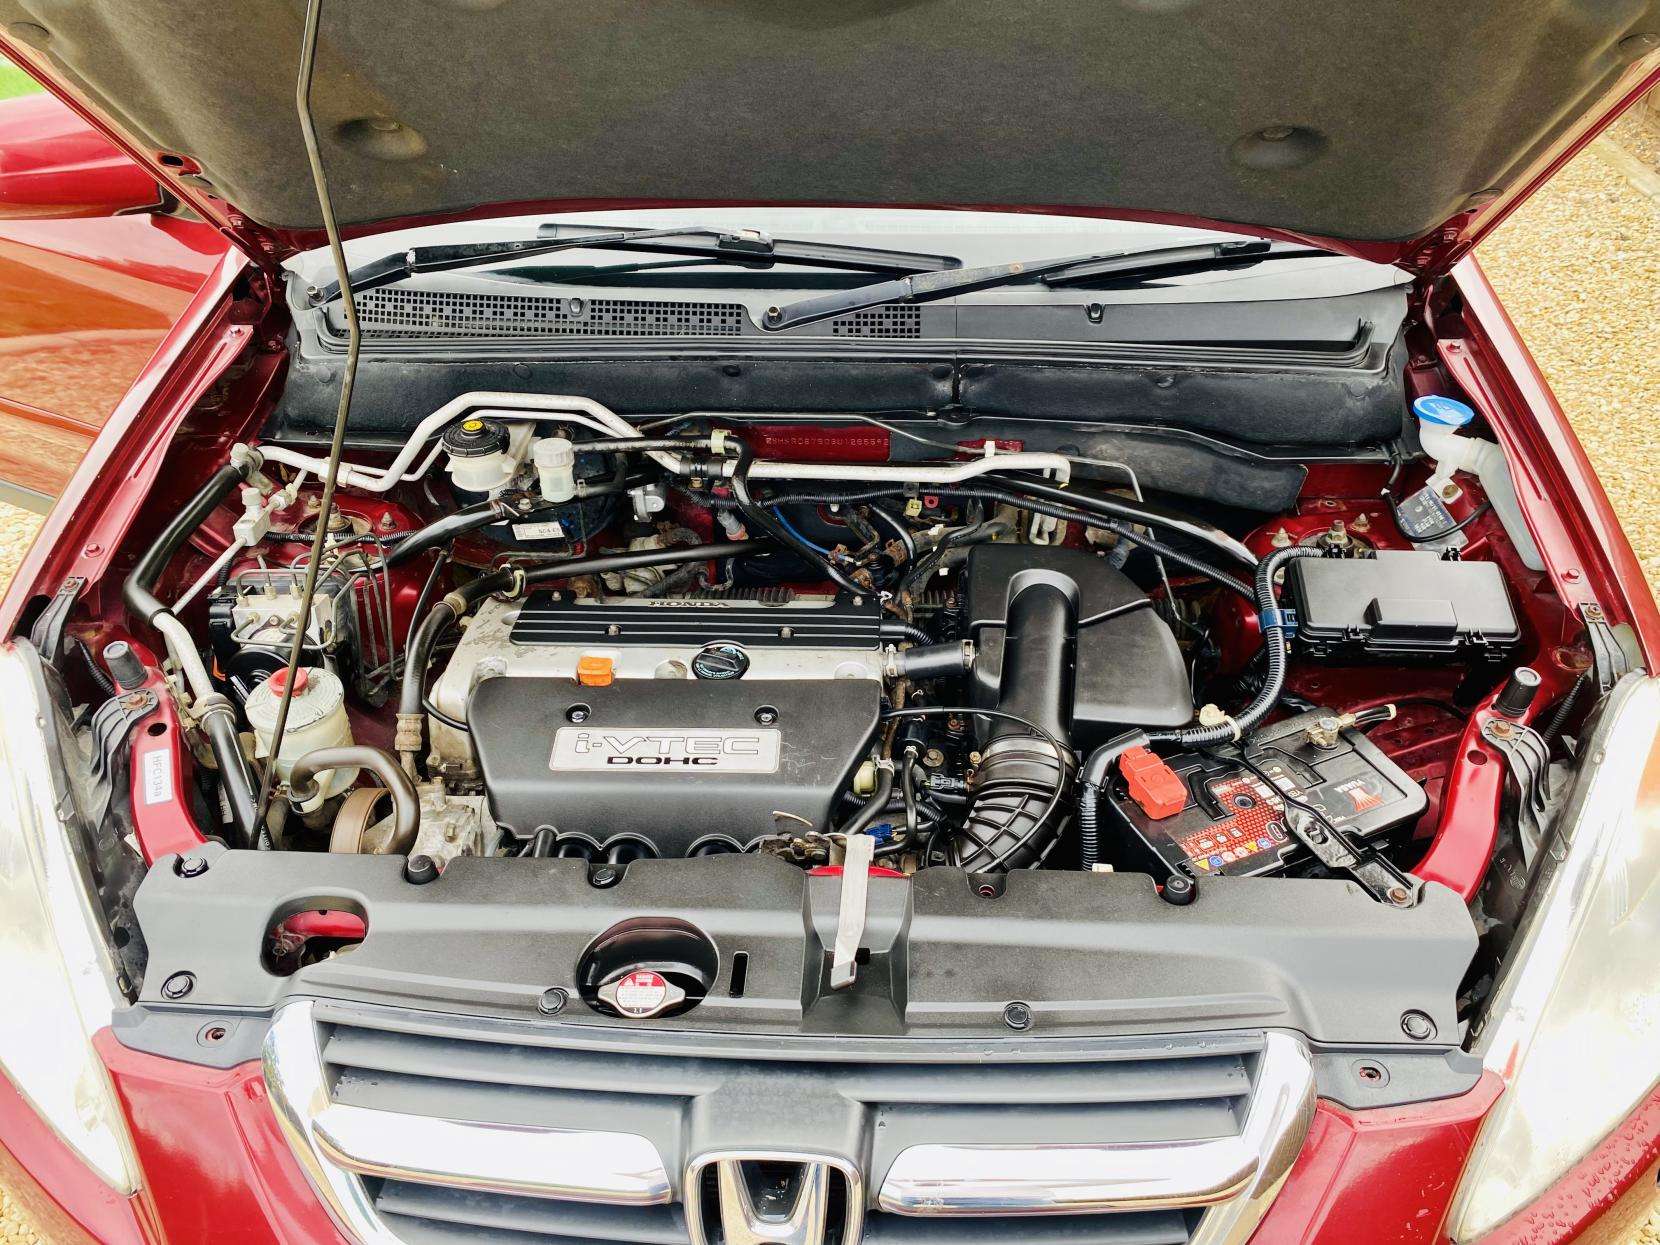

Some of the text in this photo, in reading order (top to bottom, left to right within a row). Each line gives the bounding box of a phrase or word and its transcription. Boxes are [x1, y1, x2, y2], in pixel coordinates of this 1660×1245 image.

[649, 600, 728, 608] HONDA
[574, 732, 760, 755] i-VTEC
[607, 756, 718, 765] DOHC
